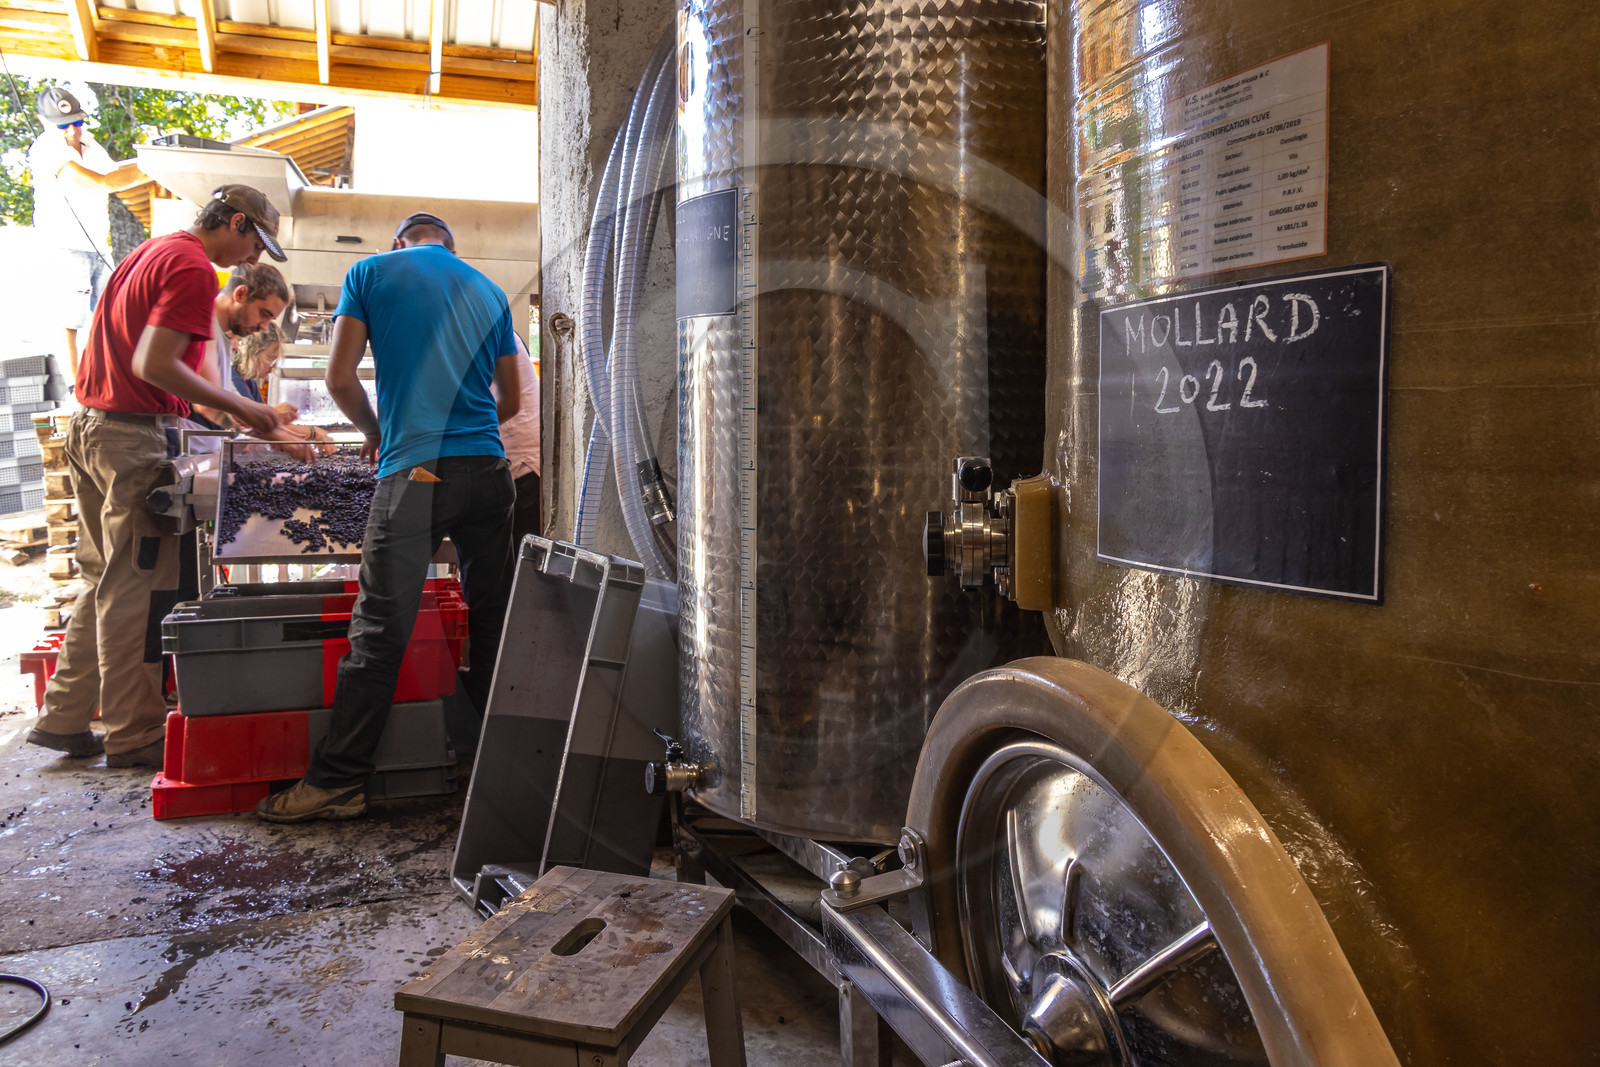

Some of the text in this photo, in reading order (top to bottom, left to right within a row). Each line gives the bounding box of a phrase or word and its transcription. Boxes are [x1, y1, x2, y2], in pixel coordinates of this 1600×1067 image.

[1172, 137, 1194, 150] PLAQUE
[1196, 119, 1250, 142] D'IDENTIFICATION
[1252, 111, 1270, 123] CUVE
[1226, 132, 1256, 146] Commande
[1280, 133, 1308, 144] Oenologie
[1218, 170, 1234, 180] Produit
[1268, 206, 1293, 216] EUROGEL
[1277, 241, 1308, 251] Translucide
[1125, 292, 1321, 356] MOLLARD
[1153, 356, 1269, 414] 2022
